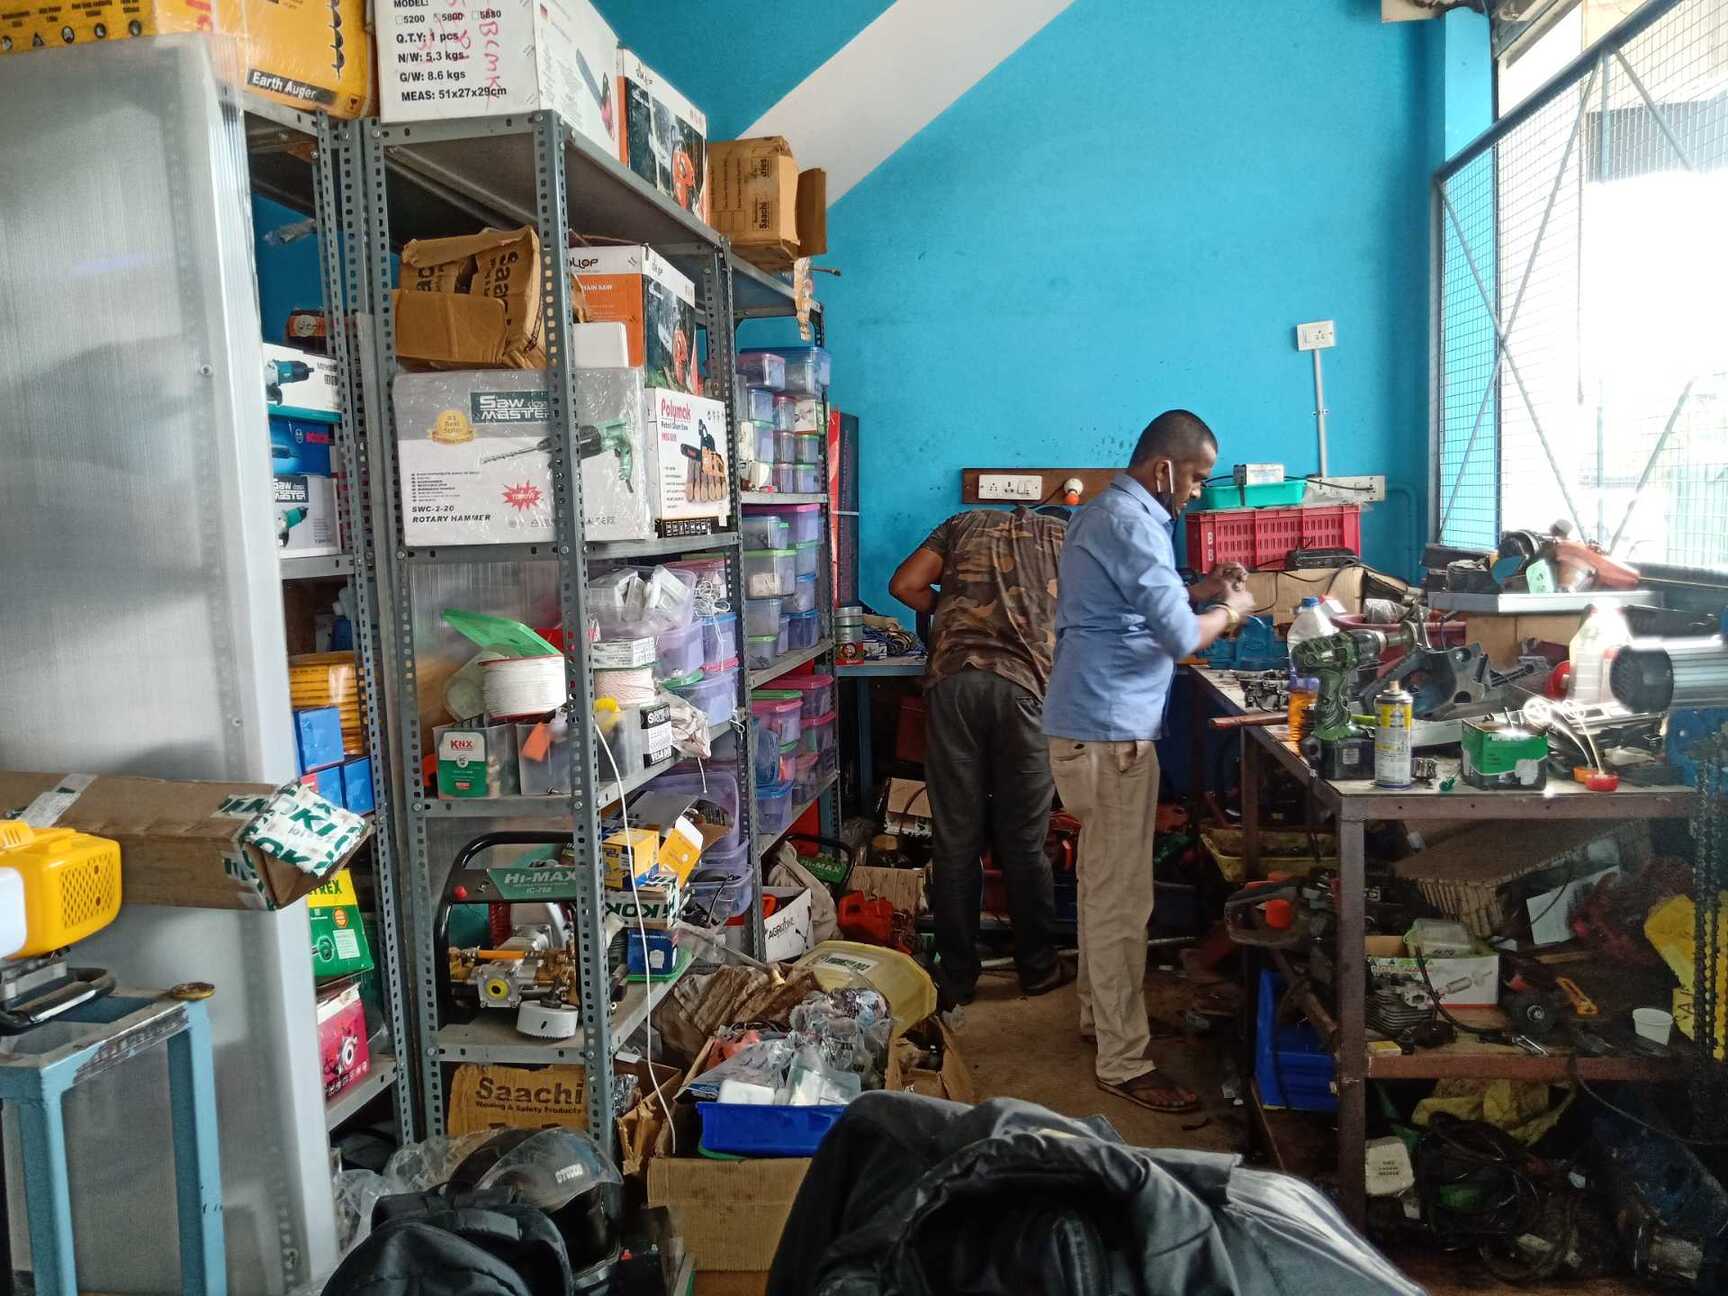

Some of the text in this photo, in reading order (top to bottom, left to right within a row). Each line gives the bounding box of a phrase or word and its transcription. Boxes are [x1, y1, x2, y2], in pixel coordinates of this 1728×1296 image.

[394, 0, 429, 8] MODEL:
[404, 15, 425, 24] 5200
[440, 32, 459, 42] pcs
[398, 51, 464, 63] N/W: 5.3 kgs
[400, 70, 466, 83] G/W: 8.6 kgs
[252, 71, 317, 99] Earth Auger
[401, 87, 507, 102] MEAS: 51x27x29cm
[660, 398, 692, 424] Polymak
[412, 514, 491, 523] ROTARY HAMMER
[475, 1076, 585, 1105] Saachi
[515, 1105, 542, 1113] Safety
[543, 1106, 582, 1114] Products
